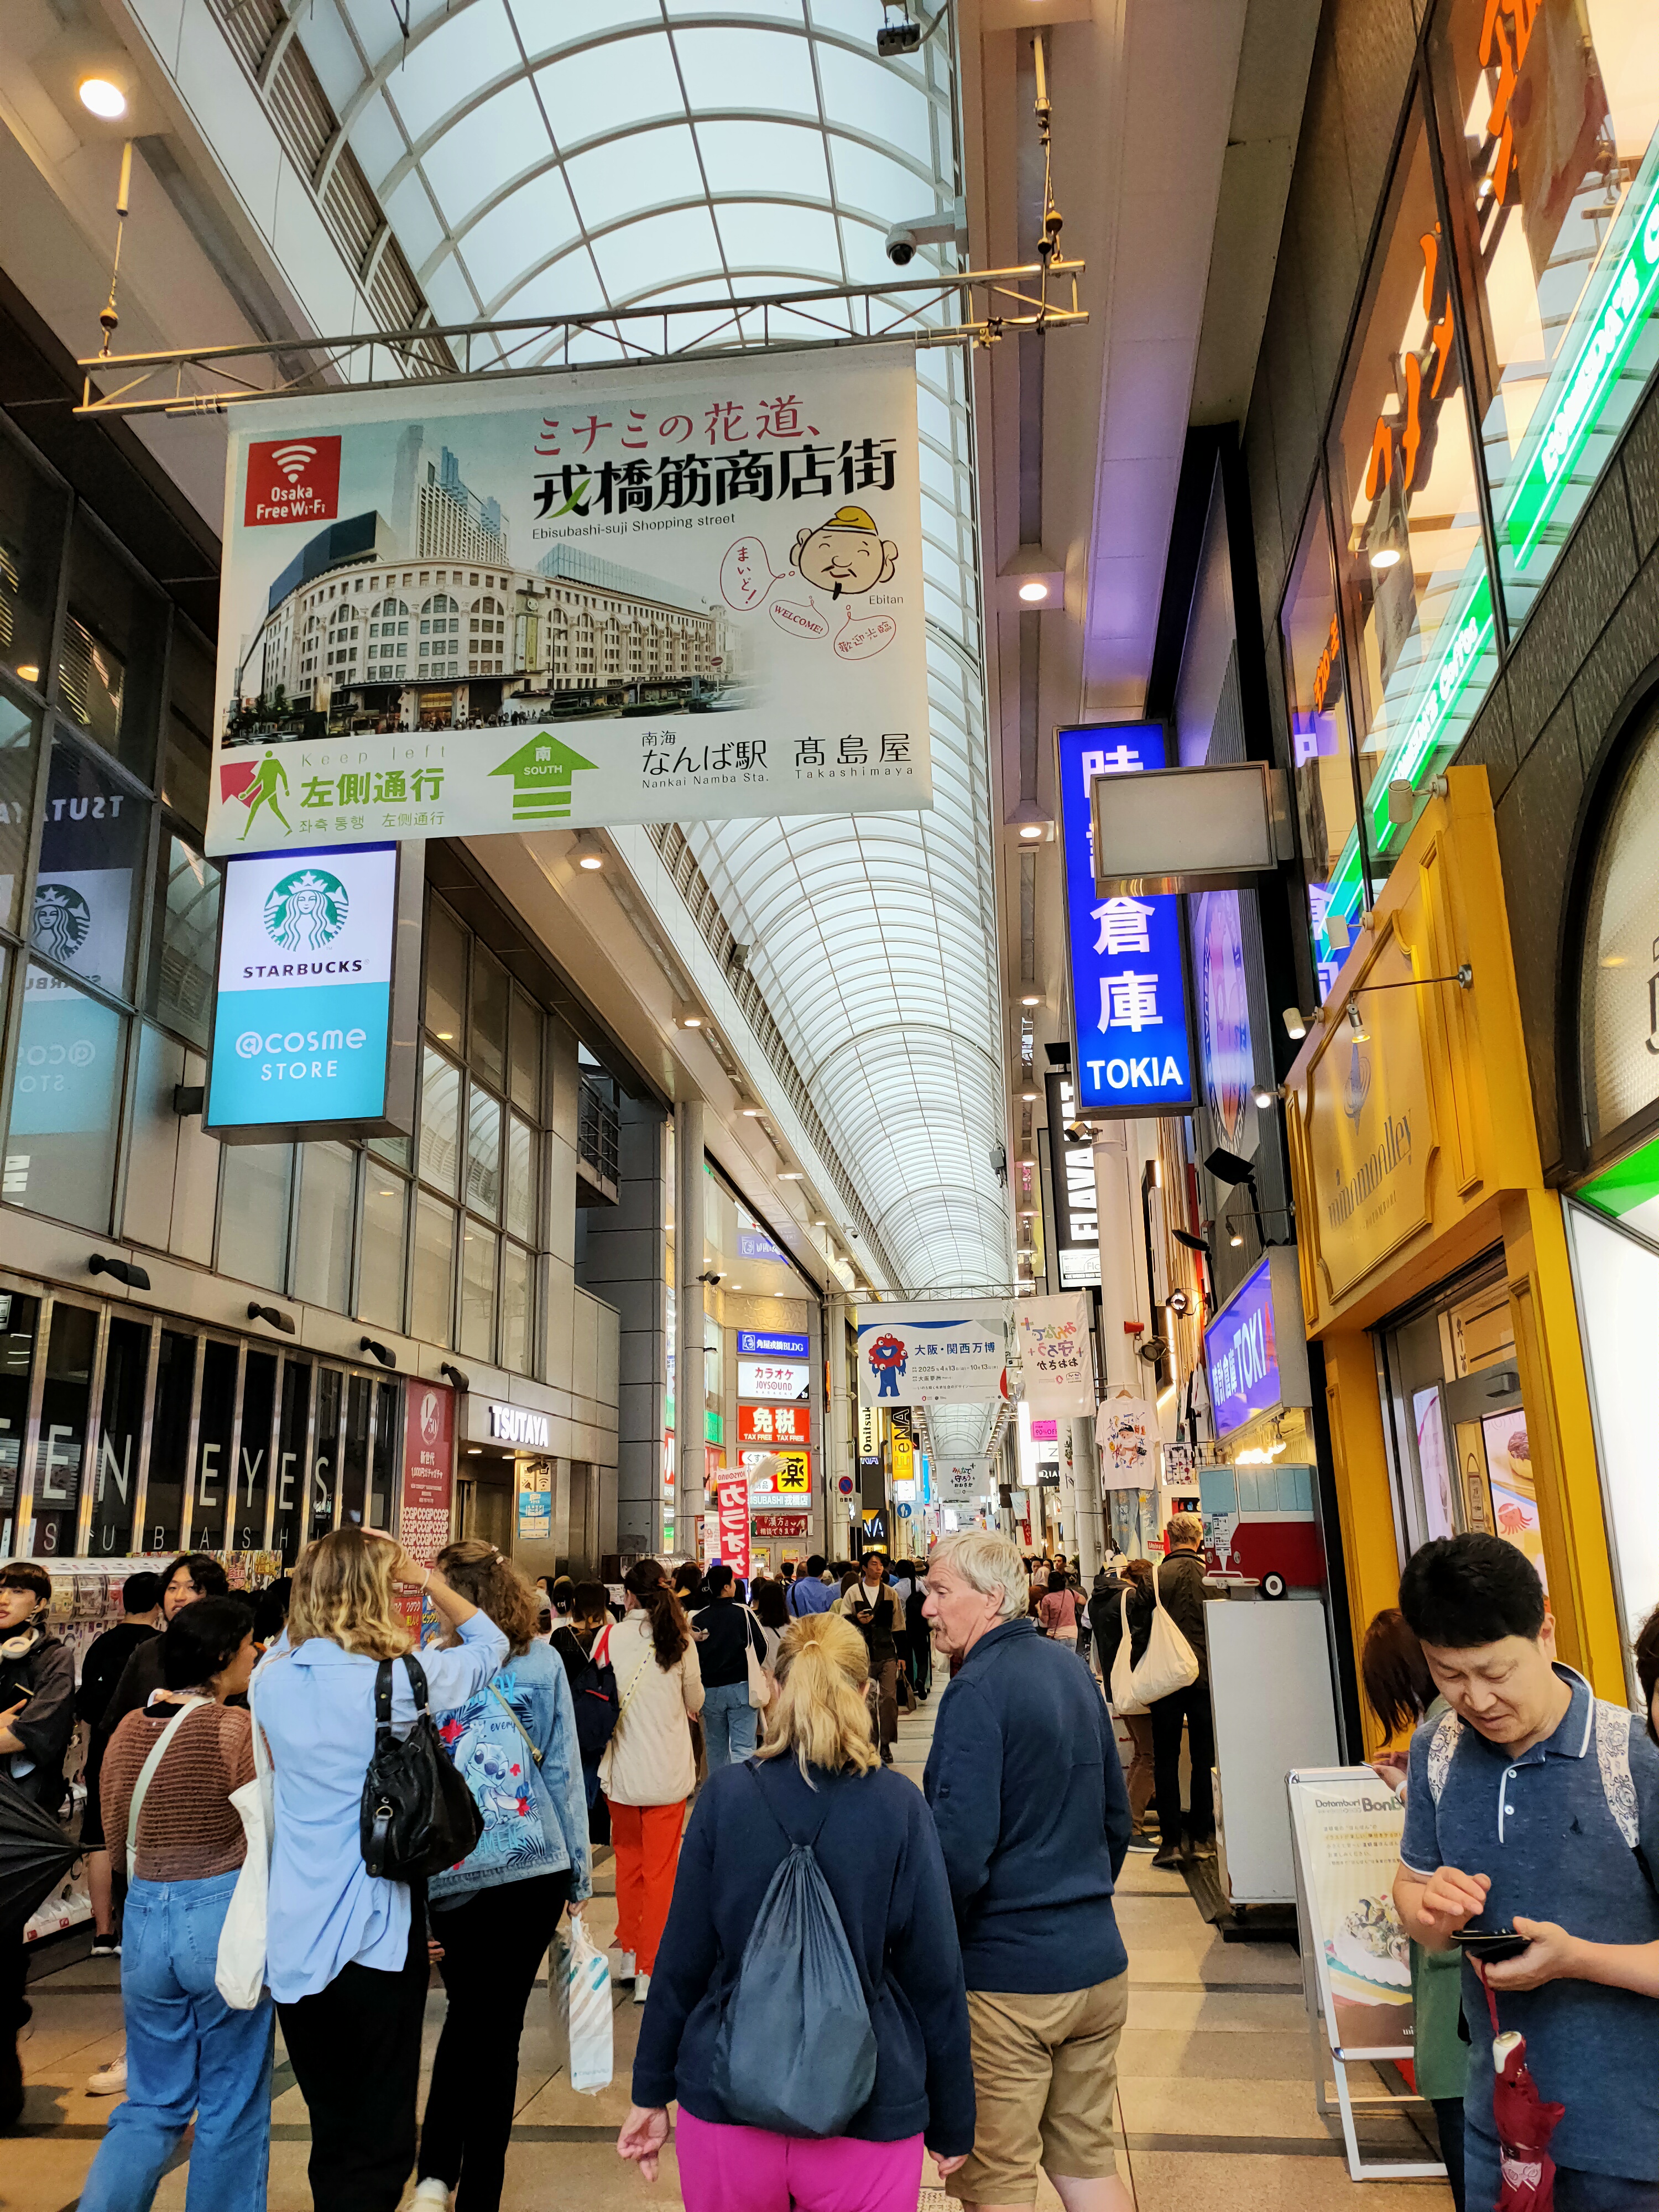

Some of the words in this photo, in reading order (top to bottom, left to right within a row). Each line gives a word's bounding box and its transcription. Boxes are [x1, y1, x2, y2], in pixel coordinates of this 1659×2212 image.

[533, 395, 821, 456] ミナミの花道、
[533, 438, 897, 520] 戎橋筋商店街
[270, 484, 314, 502] Osaka
[256, 503, 288, 520] Free
[290, 499, 326, 517] Wi-Fi
[532, 520, 628, 541] Ebisubashi-suji
[632, 515, 693, 533] Shopping
[697, 513, 736, 527] street
[869, 594, 904, 606] Ebitan
[774, 604, 824, 635] WELCOME!
[641, 730, 677, 747] 南海
[301, 751, 369, 769] Keep
[392, 744, 446, 762] left
[535, 745, 551, 763] 南
[641, 740, 769, 776] なんば駅
[523, 764, 564, 776] SOUTH
[641, 776, 687, 790] Nankai
[692, 773, 737, 786] Namba
[743, 771, 770, 784] Sta.
[795, 766, 914, 780] Takashimaya
[300, 768, 445, 808] 左側通行
[298, 818, 330, 834] 좌측
[334, 815, 366, 831] 통행
[243, 959, 363, 979] STARBUCKS
[235, 1028, 367, 1059] @cosme
[260, 1060, 338, 1082] STORE
[1086, 1056, 1184, 1091] TOKIA
[914, 1341, 995, 1355] 大阪・関西万博
[755, 1367, 794, 1381] カラオケ
[756, 1381, 792, 1391] JOYSOUND
[489, 1405, 549, 1448] TSUTAYA
[753, 1407, 795, 1434] 免税
[199, 1442, 329, 1515] EYES
[781, 1457, 805, 1488] 薬
[784, 1495, 808, 1506] 戎橋店
